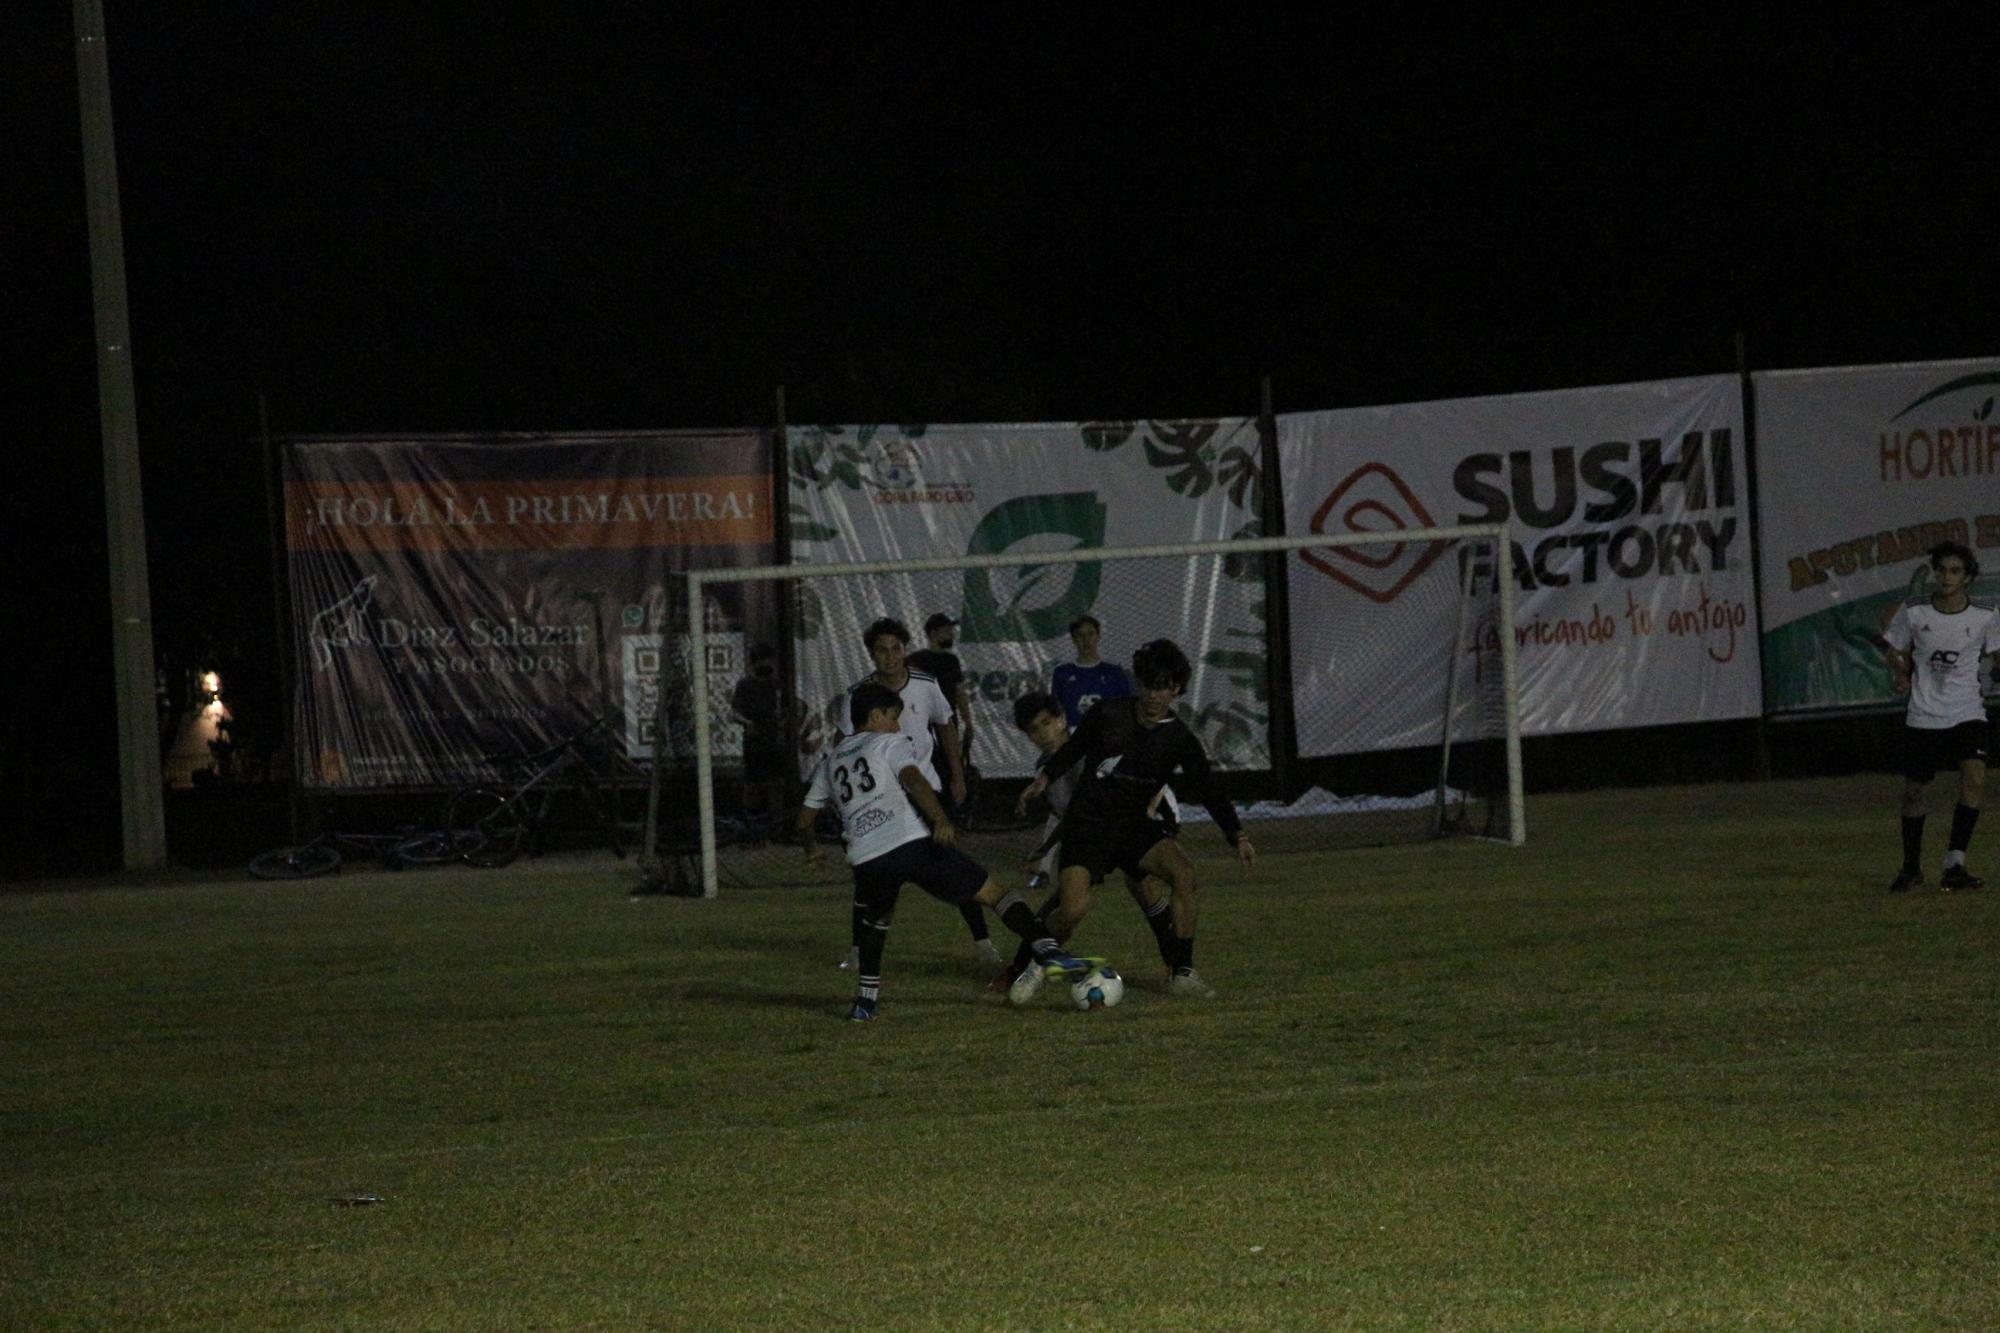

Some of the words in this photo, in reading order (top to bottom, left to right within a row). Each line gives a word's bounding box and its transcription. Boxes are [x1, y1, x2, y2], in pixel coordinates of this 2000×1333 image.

[444, 496, 495, 526] LA
[506, 491, 754, 525] PRIMAVERA!
[1453, 428, 1735, 528] SUSHI
[1458, 516, 1736, 596] FACTORY
[470, 617, 589, 647] Salazar
[1626, 588, 1651, 636] tu
[1668, 582, 1746, 662] antojo
[834, 756, 876, 803] 33
